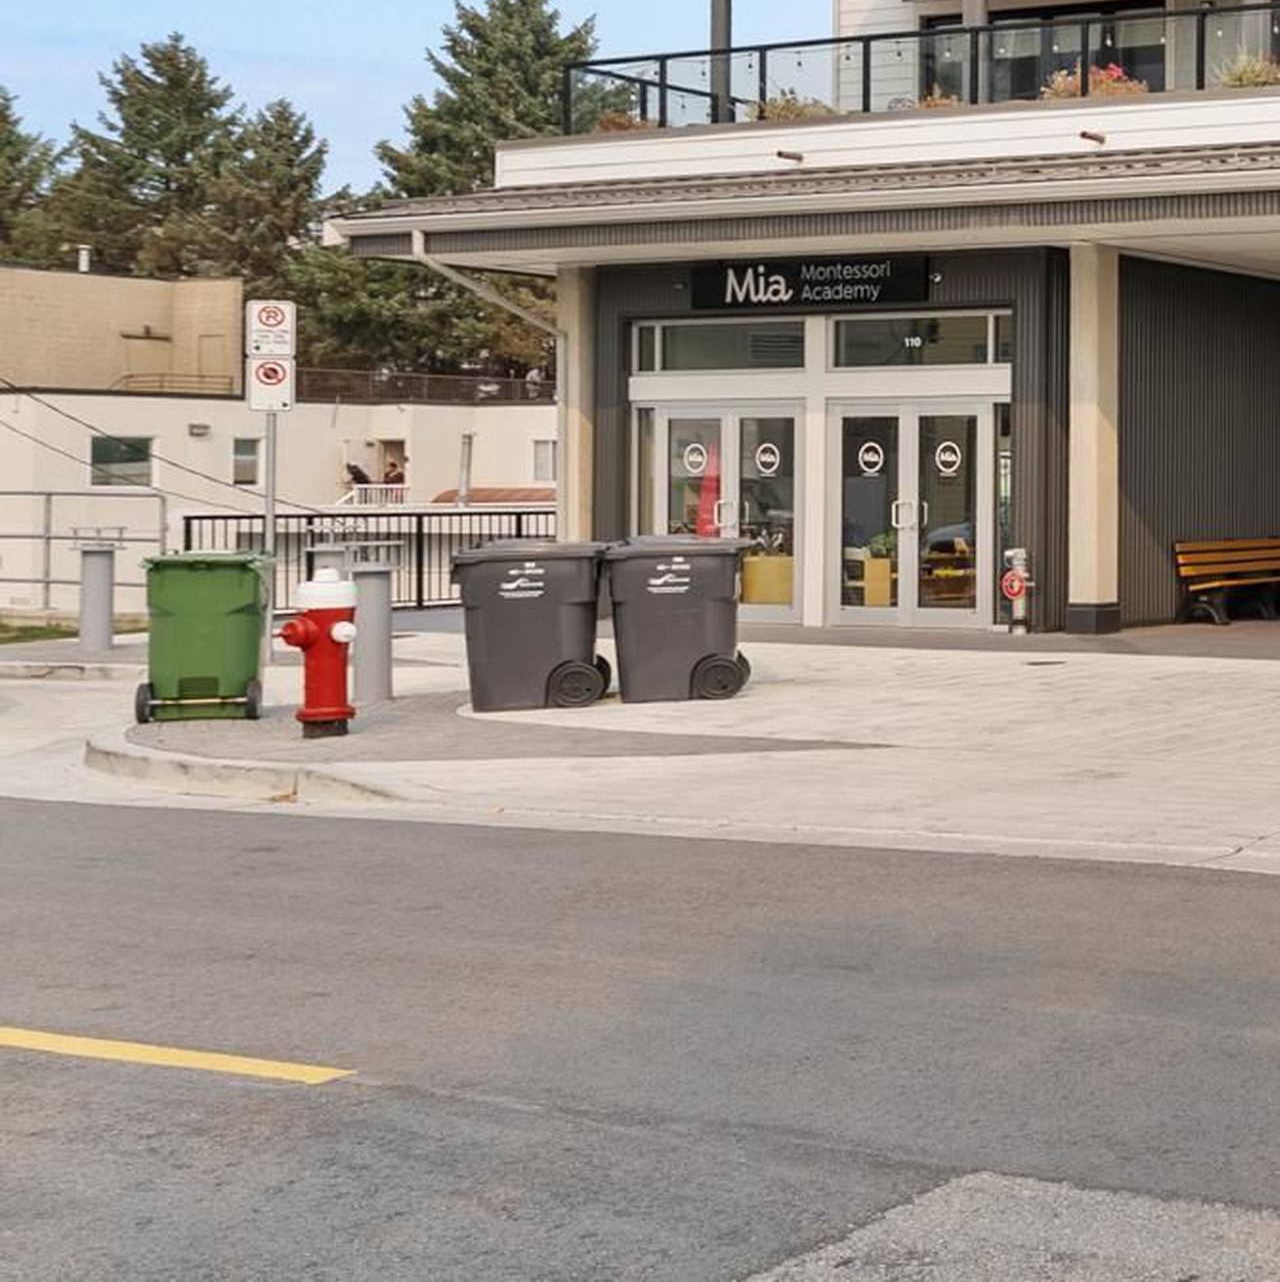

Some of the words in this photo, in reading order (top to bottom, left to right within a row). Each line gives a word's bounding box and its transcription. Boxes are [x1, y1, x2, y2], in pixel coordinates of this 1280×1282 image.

[800, 260, 892, 281] Montessori
[725, 264, 794, 304] Mia
[801, 282, 881, 302] Academy
[904, 336, 922, 348] 110
